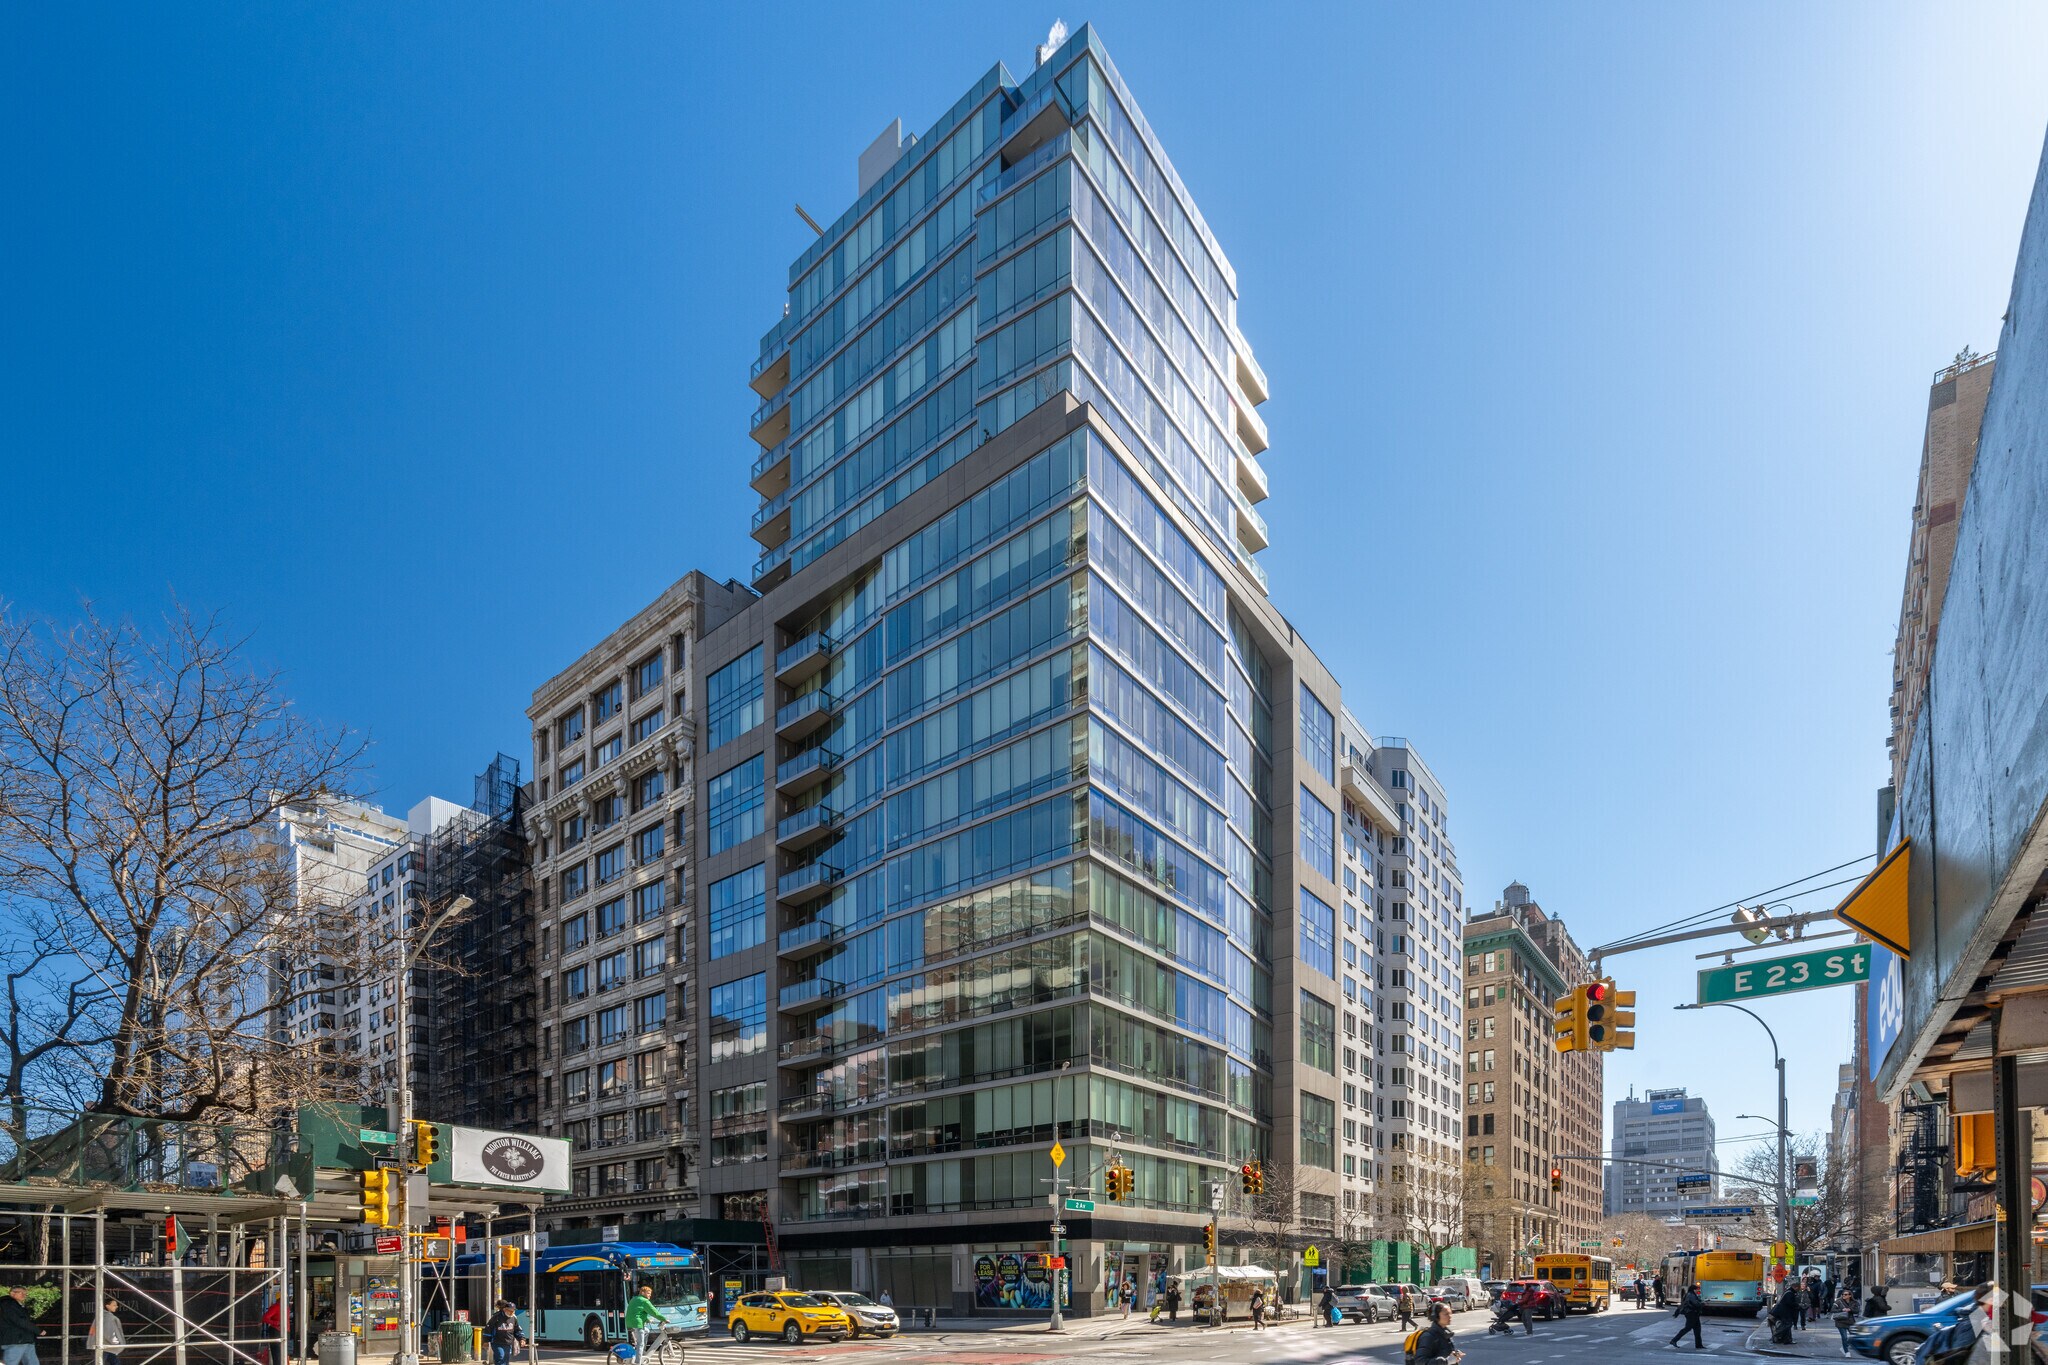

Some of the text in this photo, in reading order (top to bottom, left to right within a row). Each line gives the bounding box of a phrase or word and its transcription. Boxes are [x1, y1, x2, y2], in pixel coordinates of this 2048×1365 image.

[1735, 952, 1865, 993] E 23 St
[484, 1138, 542, 1160] MORTON WILLIAMS
[1795, 1198, 1805, 1206] 23
[370, 1291, 399, 1299] OPEN
